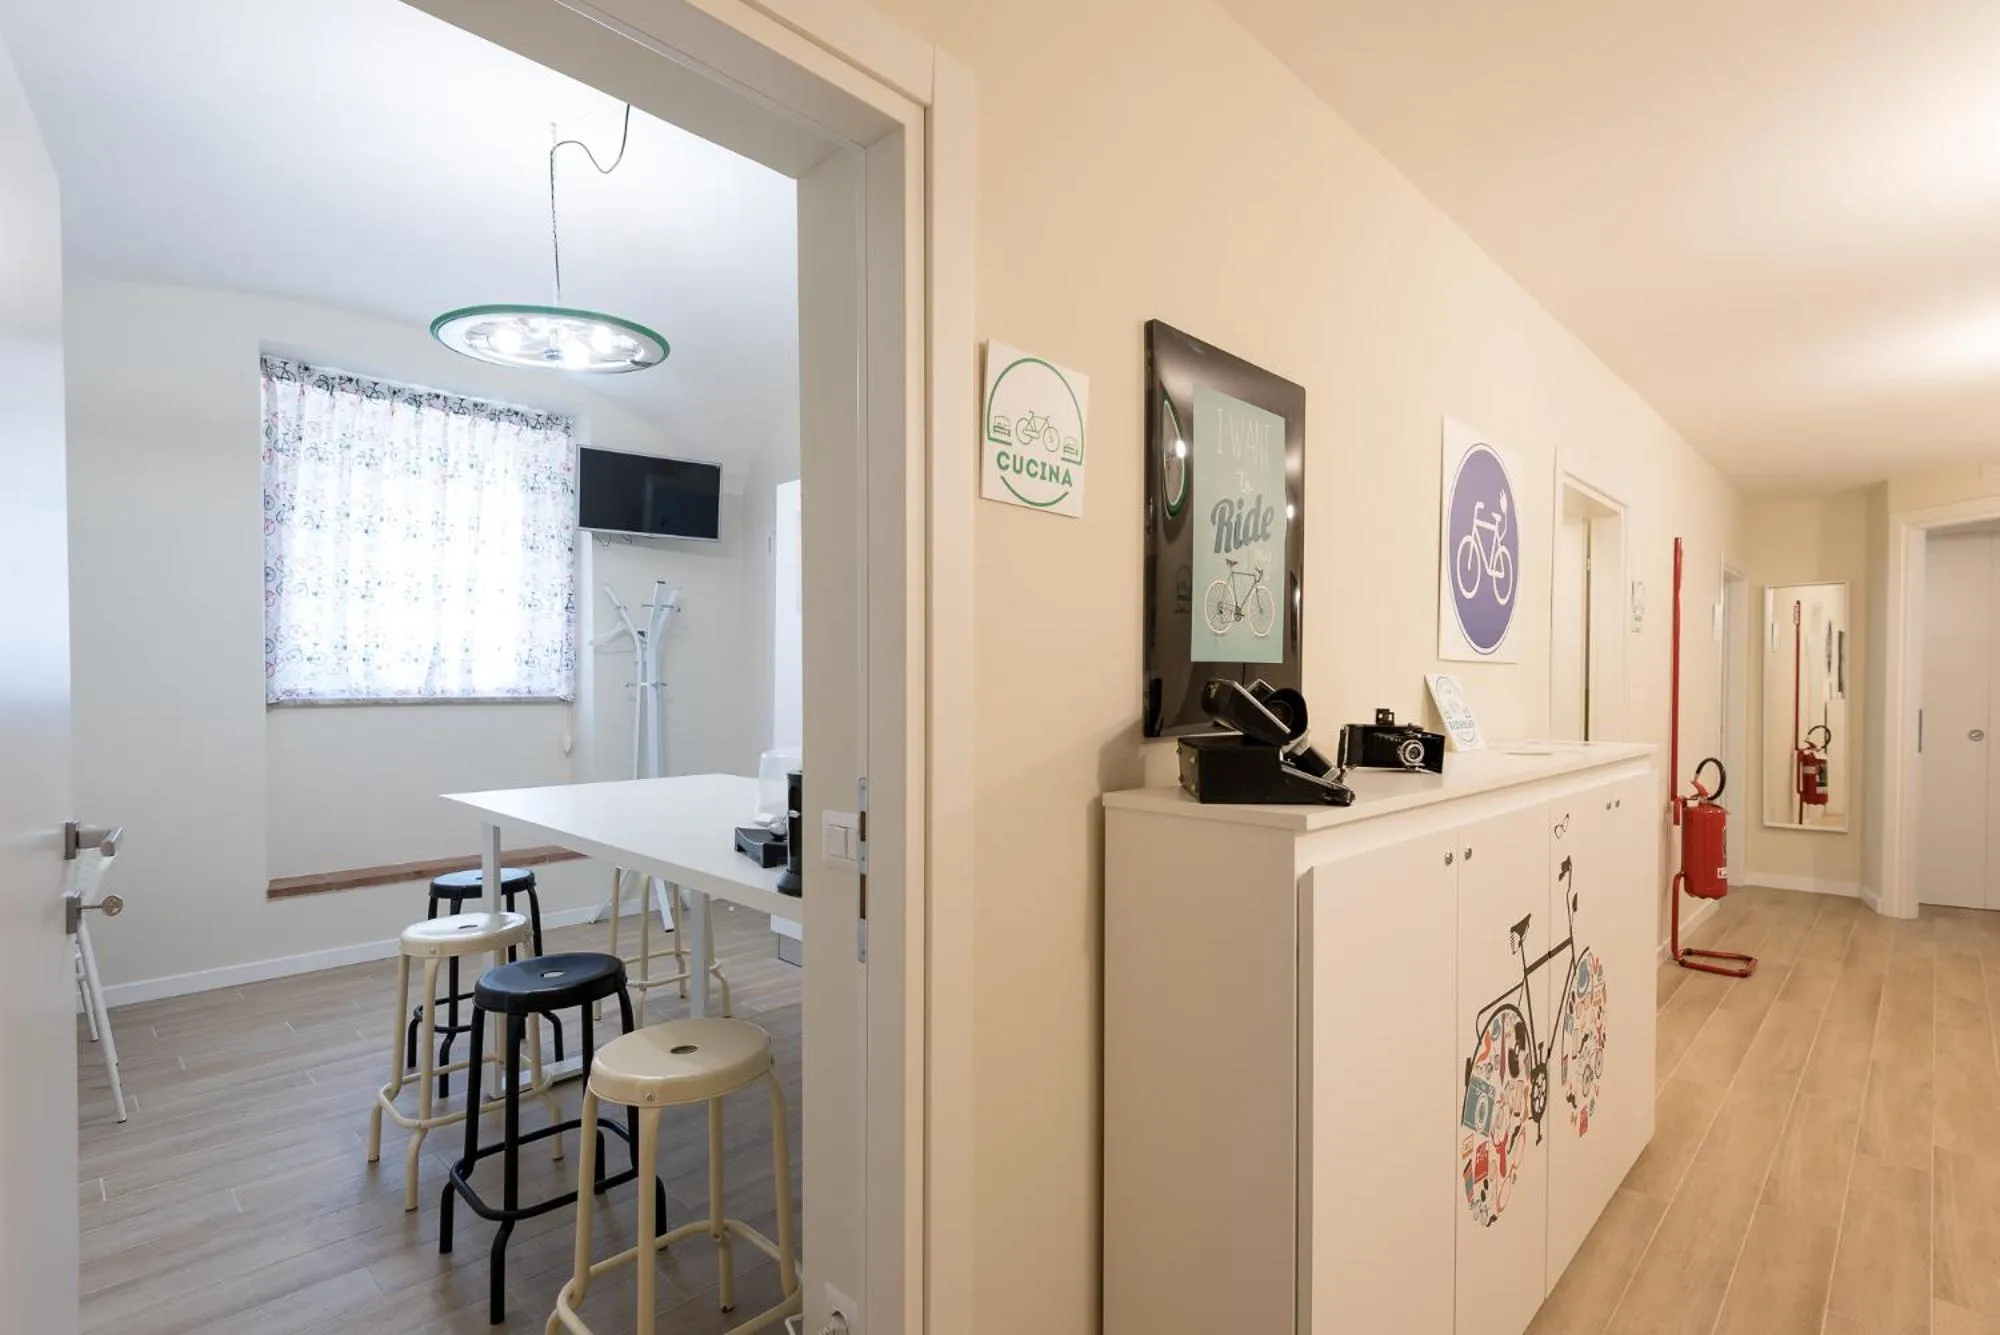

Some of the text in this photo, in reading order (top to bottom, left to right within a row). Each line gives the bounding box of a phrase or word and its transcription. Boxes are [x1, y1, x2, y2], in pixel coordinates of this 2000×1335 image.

[1216, 408, 1272, 470] I WANT
[996, 450, 1073, 488] CUCINA
[1210, 494, 1275, 553] Ride
